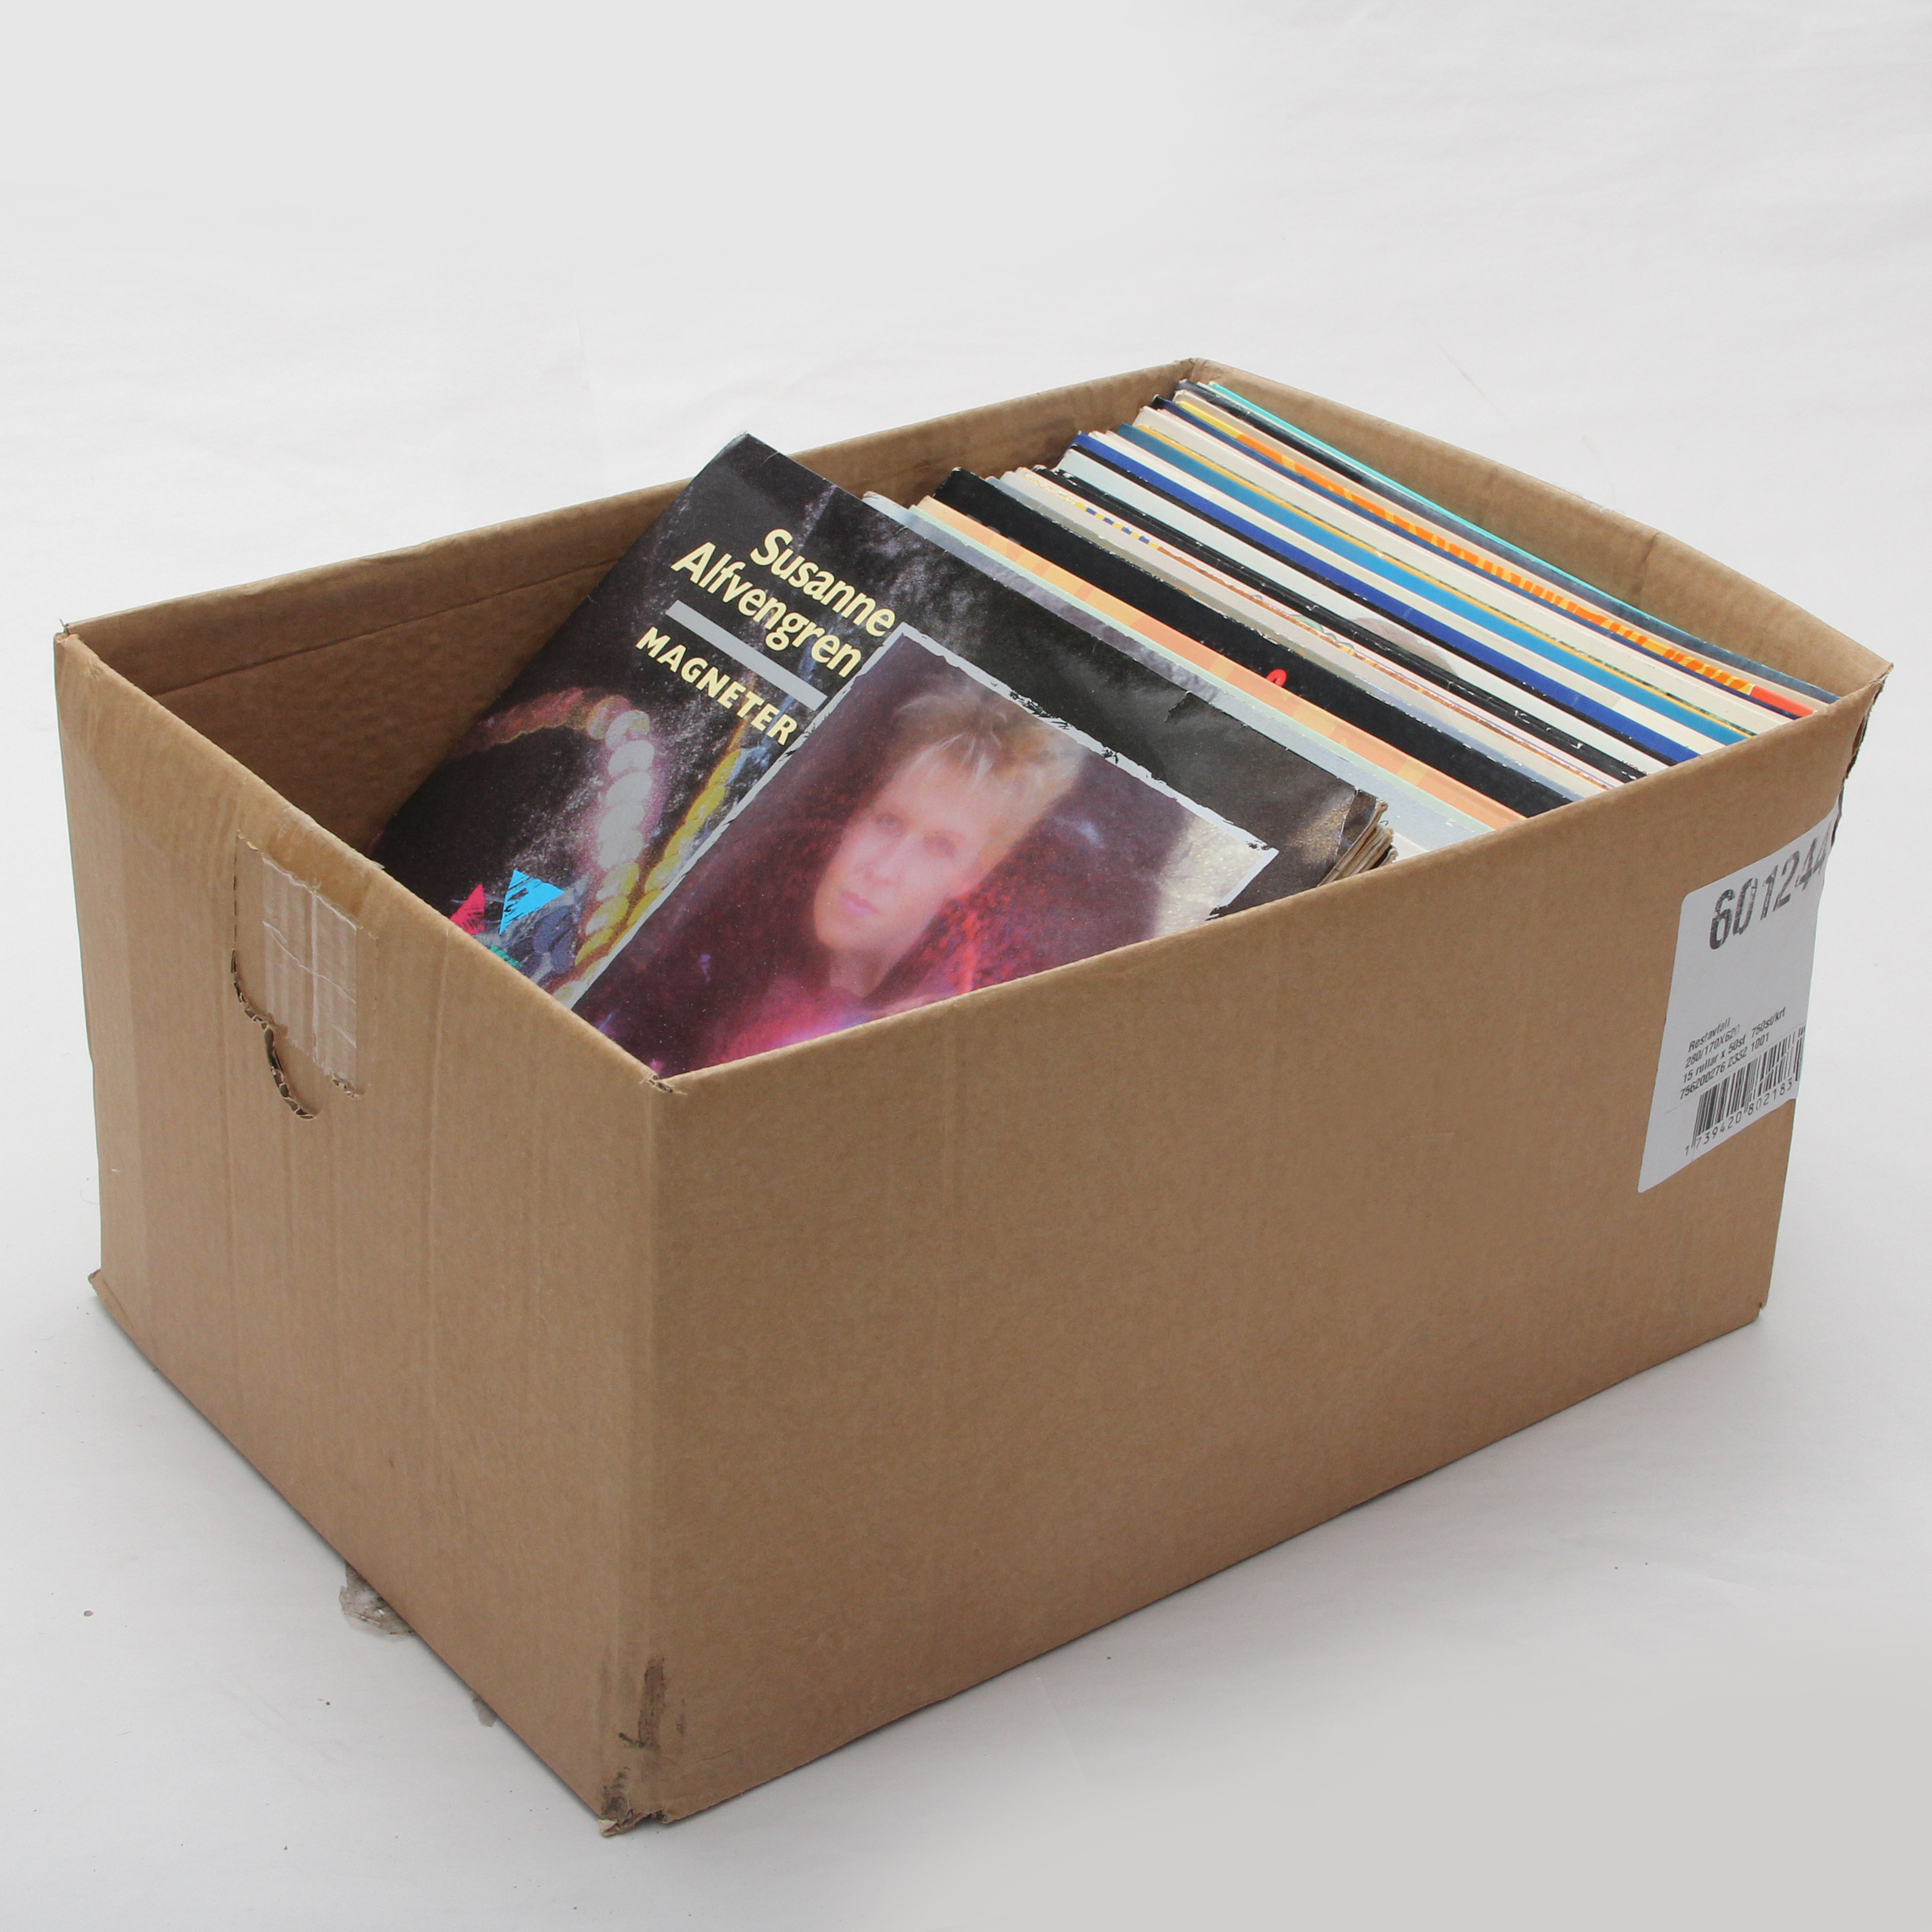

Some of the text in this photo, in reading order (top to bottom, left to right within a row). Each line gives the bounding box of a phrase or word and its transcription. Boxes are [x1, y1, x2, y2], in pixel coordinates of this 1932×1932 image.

[670, 541, 862, 678] Alfvengren
[750, 528, 896, 637] Susanne
[635, 626, 798, 747] MAGNETER
[1680, 1031, 1769, 1099] 756200276 2332 1001
[1683, 1007, 1786, 1084] 15 rullar x 50st 750st/krt
[1688, 1017, 1731, 1053] Restavfall
